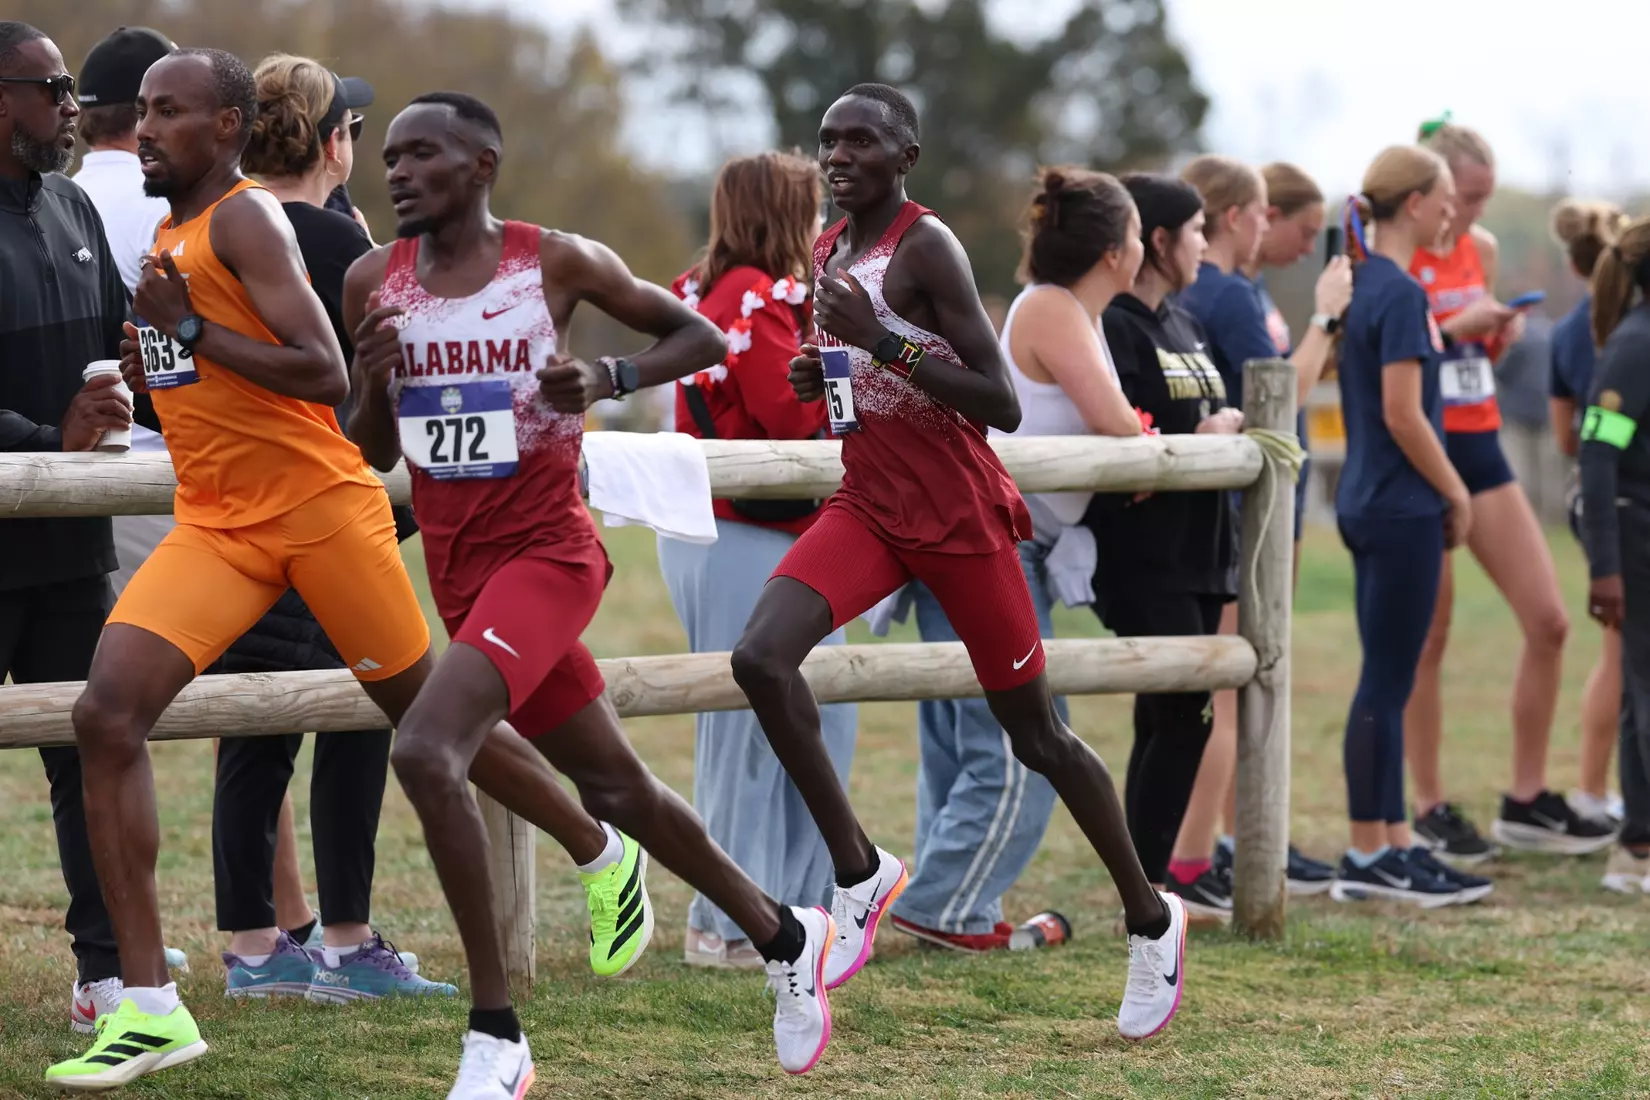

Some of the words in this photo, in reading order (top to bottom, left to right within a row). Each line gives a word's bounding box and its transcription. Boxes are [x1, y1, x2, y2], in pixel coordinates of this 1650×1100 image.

[141, 329, 175, 373] 363
[395, 339, 532, 378] ALABAMA
[426, 416, 489, 463] 272
[314, 968, 350, 987] HOKA
